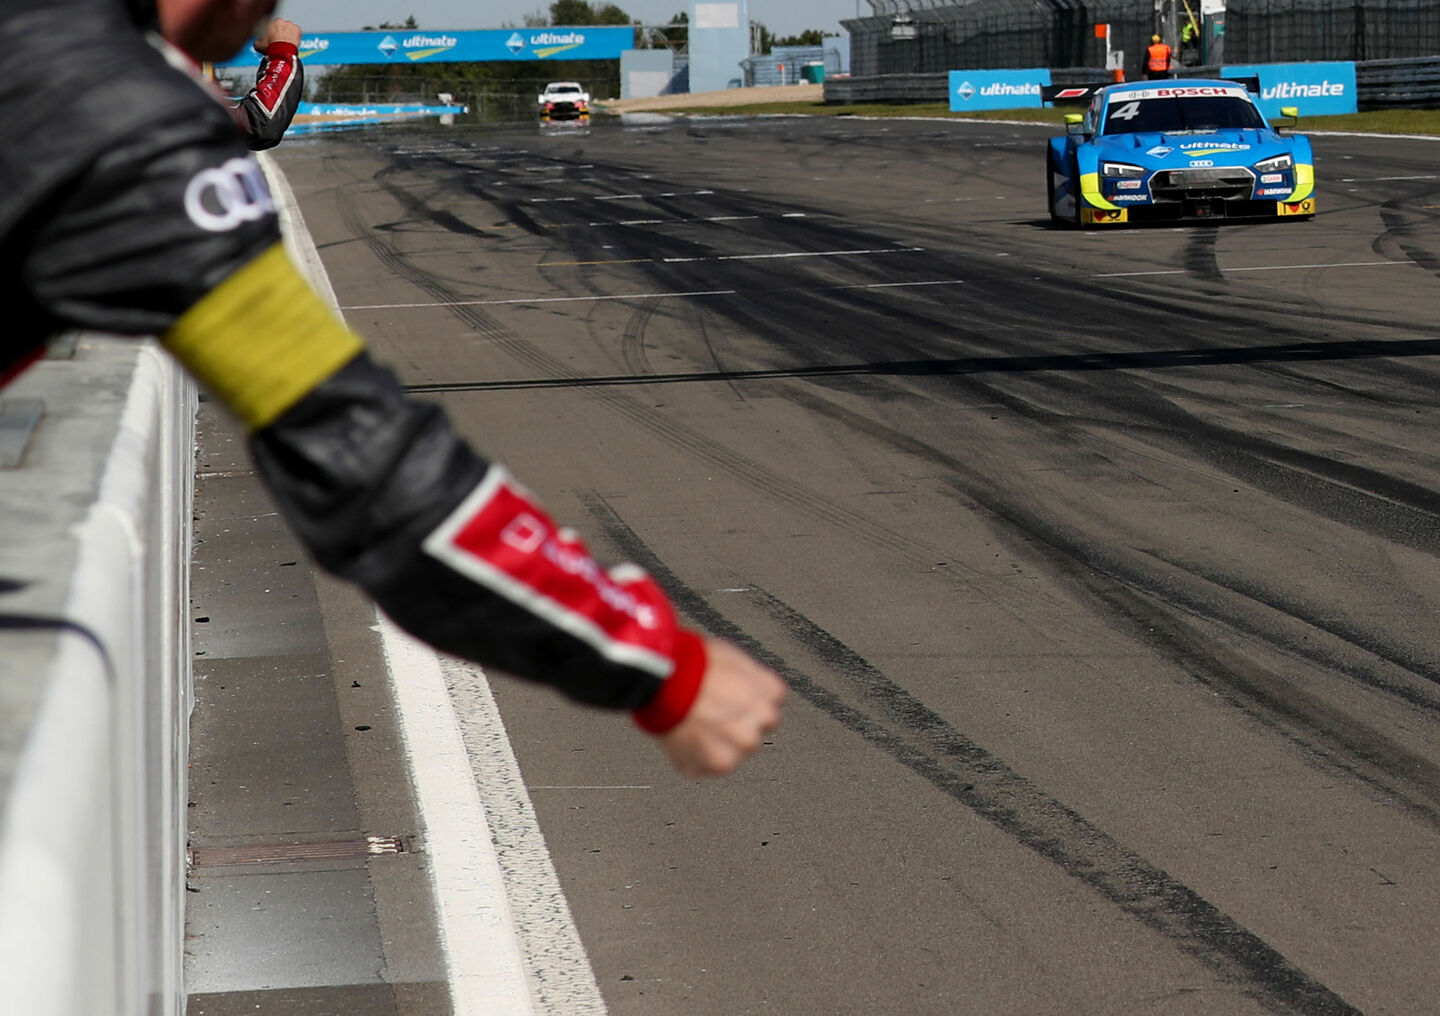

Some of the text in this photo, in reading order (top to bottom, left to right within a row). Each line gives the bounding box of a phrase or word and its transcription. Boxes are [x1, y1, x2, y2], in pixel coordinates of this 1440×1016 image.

[980, 82, 1041, 96] ultimate
[1157, 88, 1228, 97] BOSCH
[1262, 80, 1344, 100] ultimate
[1110, 101, 1141, 121] 4
[1180, 141, 1251, 150] ultimate
